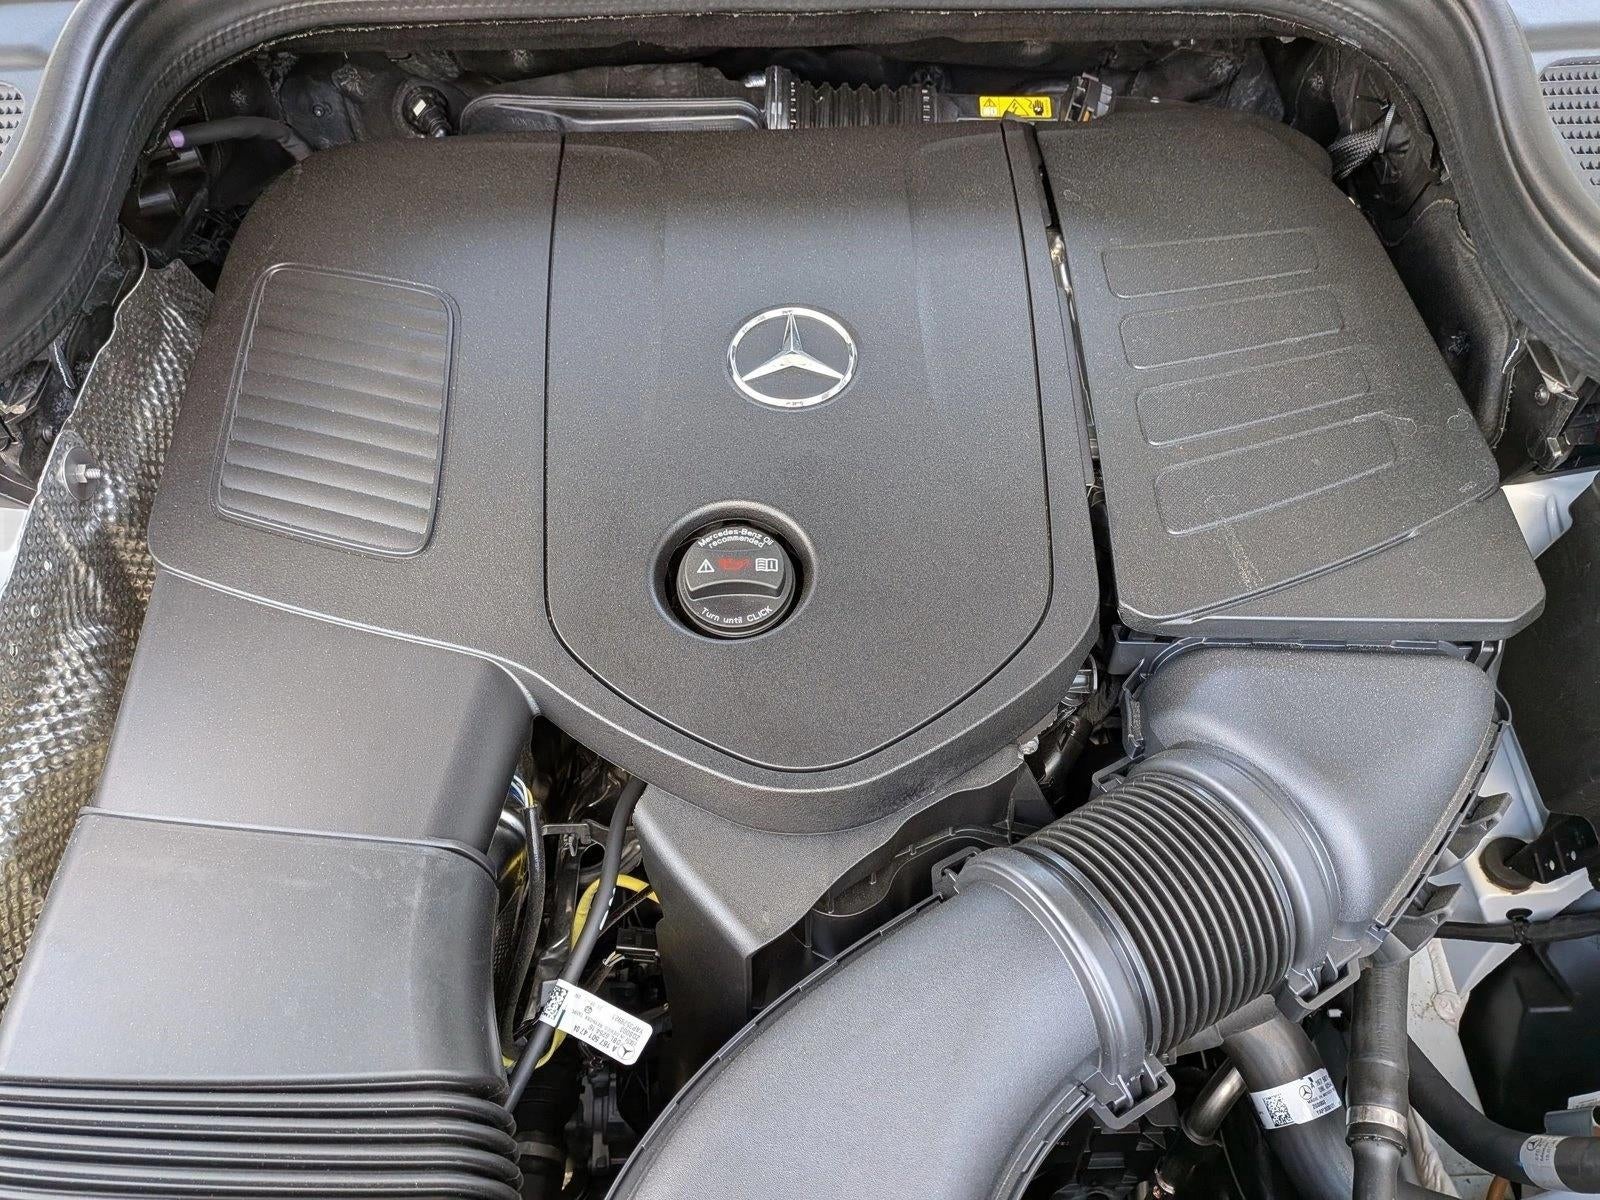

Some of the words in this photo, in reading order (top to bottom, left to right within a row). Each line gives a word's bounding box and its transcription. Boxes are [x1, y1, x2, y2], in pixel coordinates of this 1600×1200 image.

[698, 528, 762, 548] Mercedes-Benz
[763, 536, 775, 546] Oil
[709, 535, 765, 549] recommended
[702, 607, 720, 622] Turn
[723, 616, 743, 624] until
[747, 605, 773, 622] CLICK
